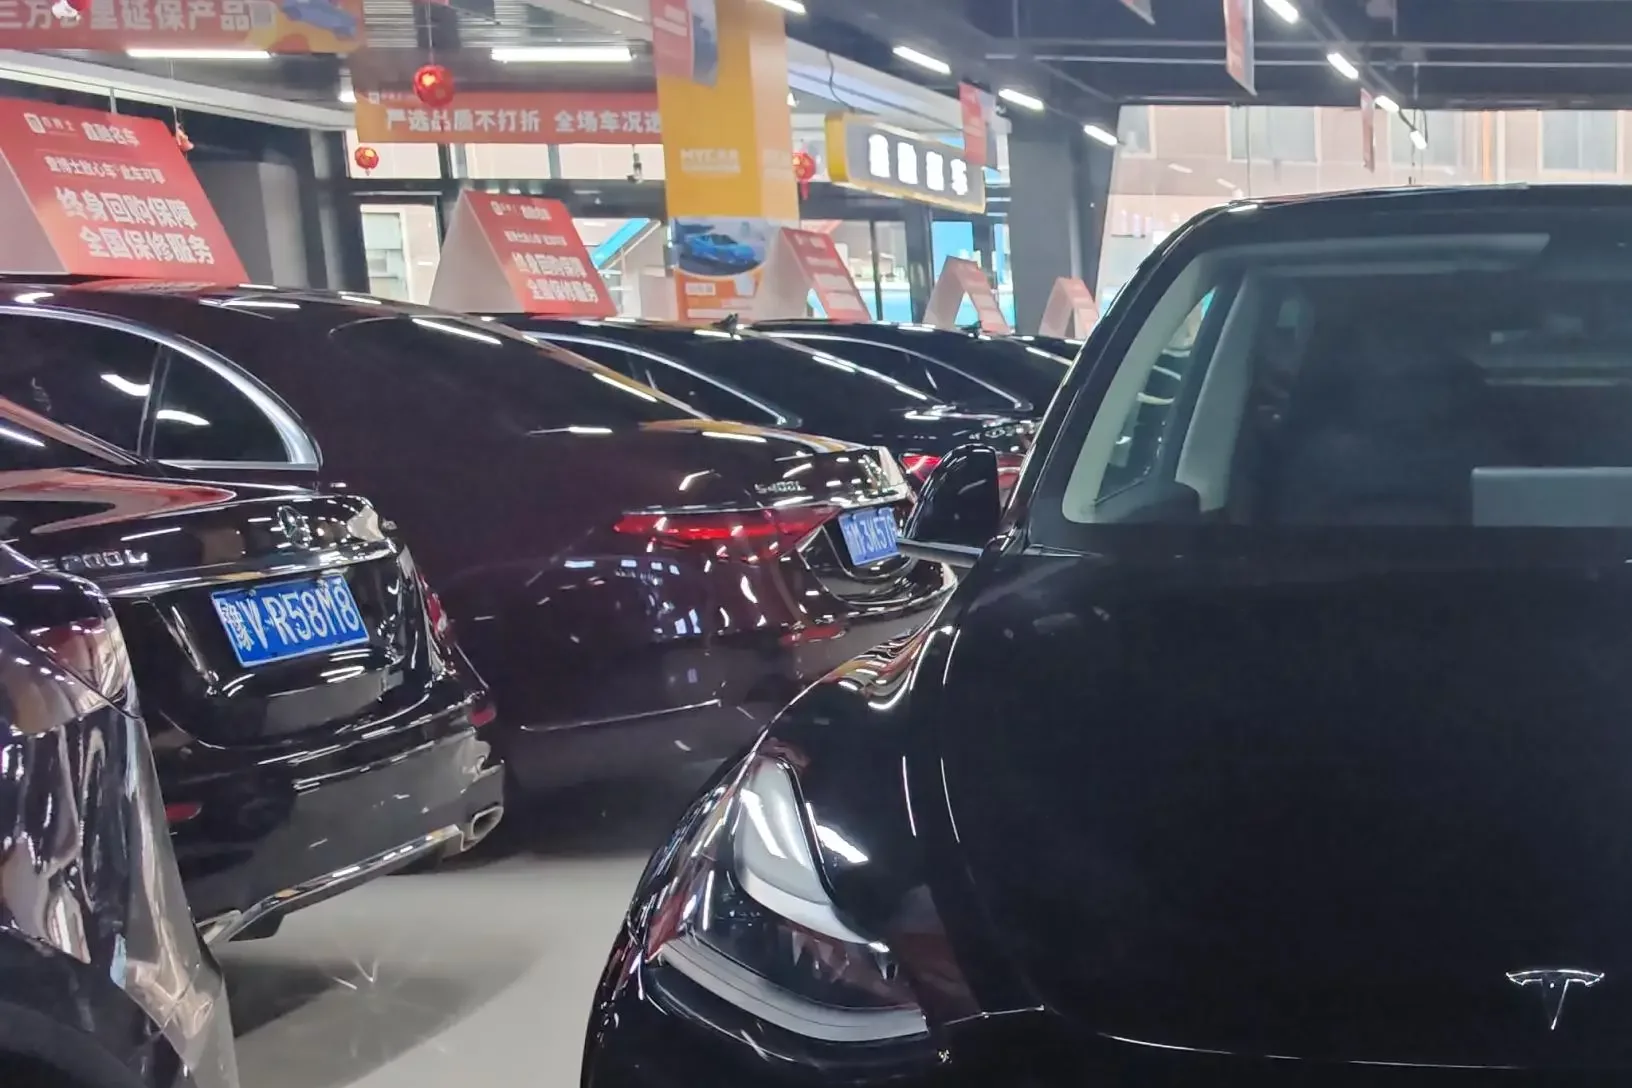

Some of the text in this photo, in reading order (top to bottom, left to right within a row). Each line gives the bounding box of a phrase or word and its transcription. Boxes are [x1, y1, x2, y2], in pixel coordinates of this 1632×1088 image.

[55, 186, 198, 230] 终身回购保障
[79, 226, 215, 265] 全国保修服务
